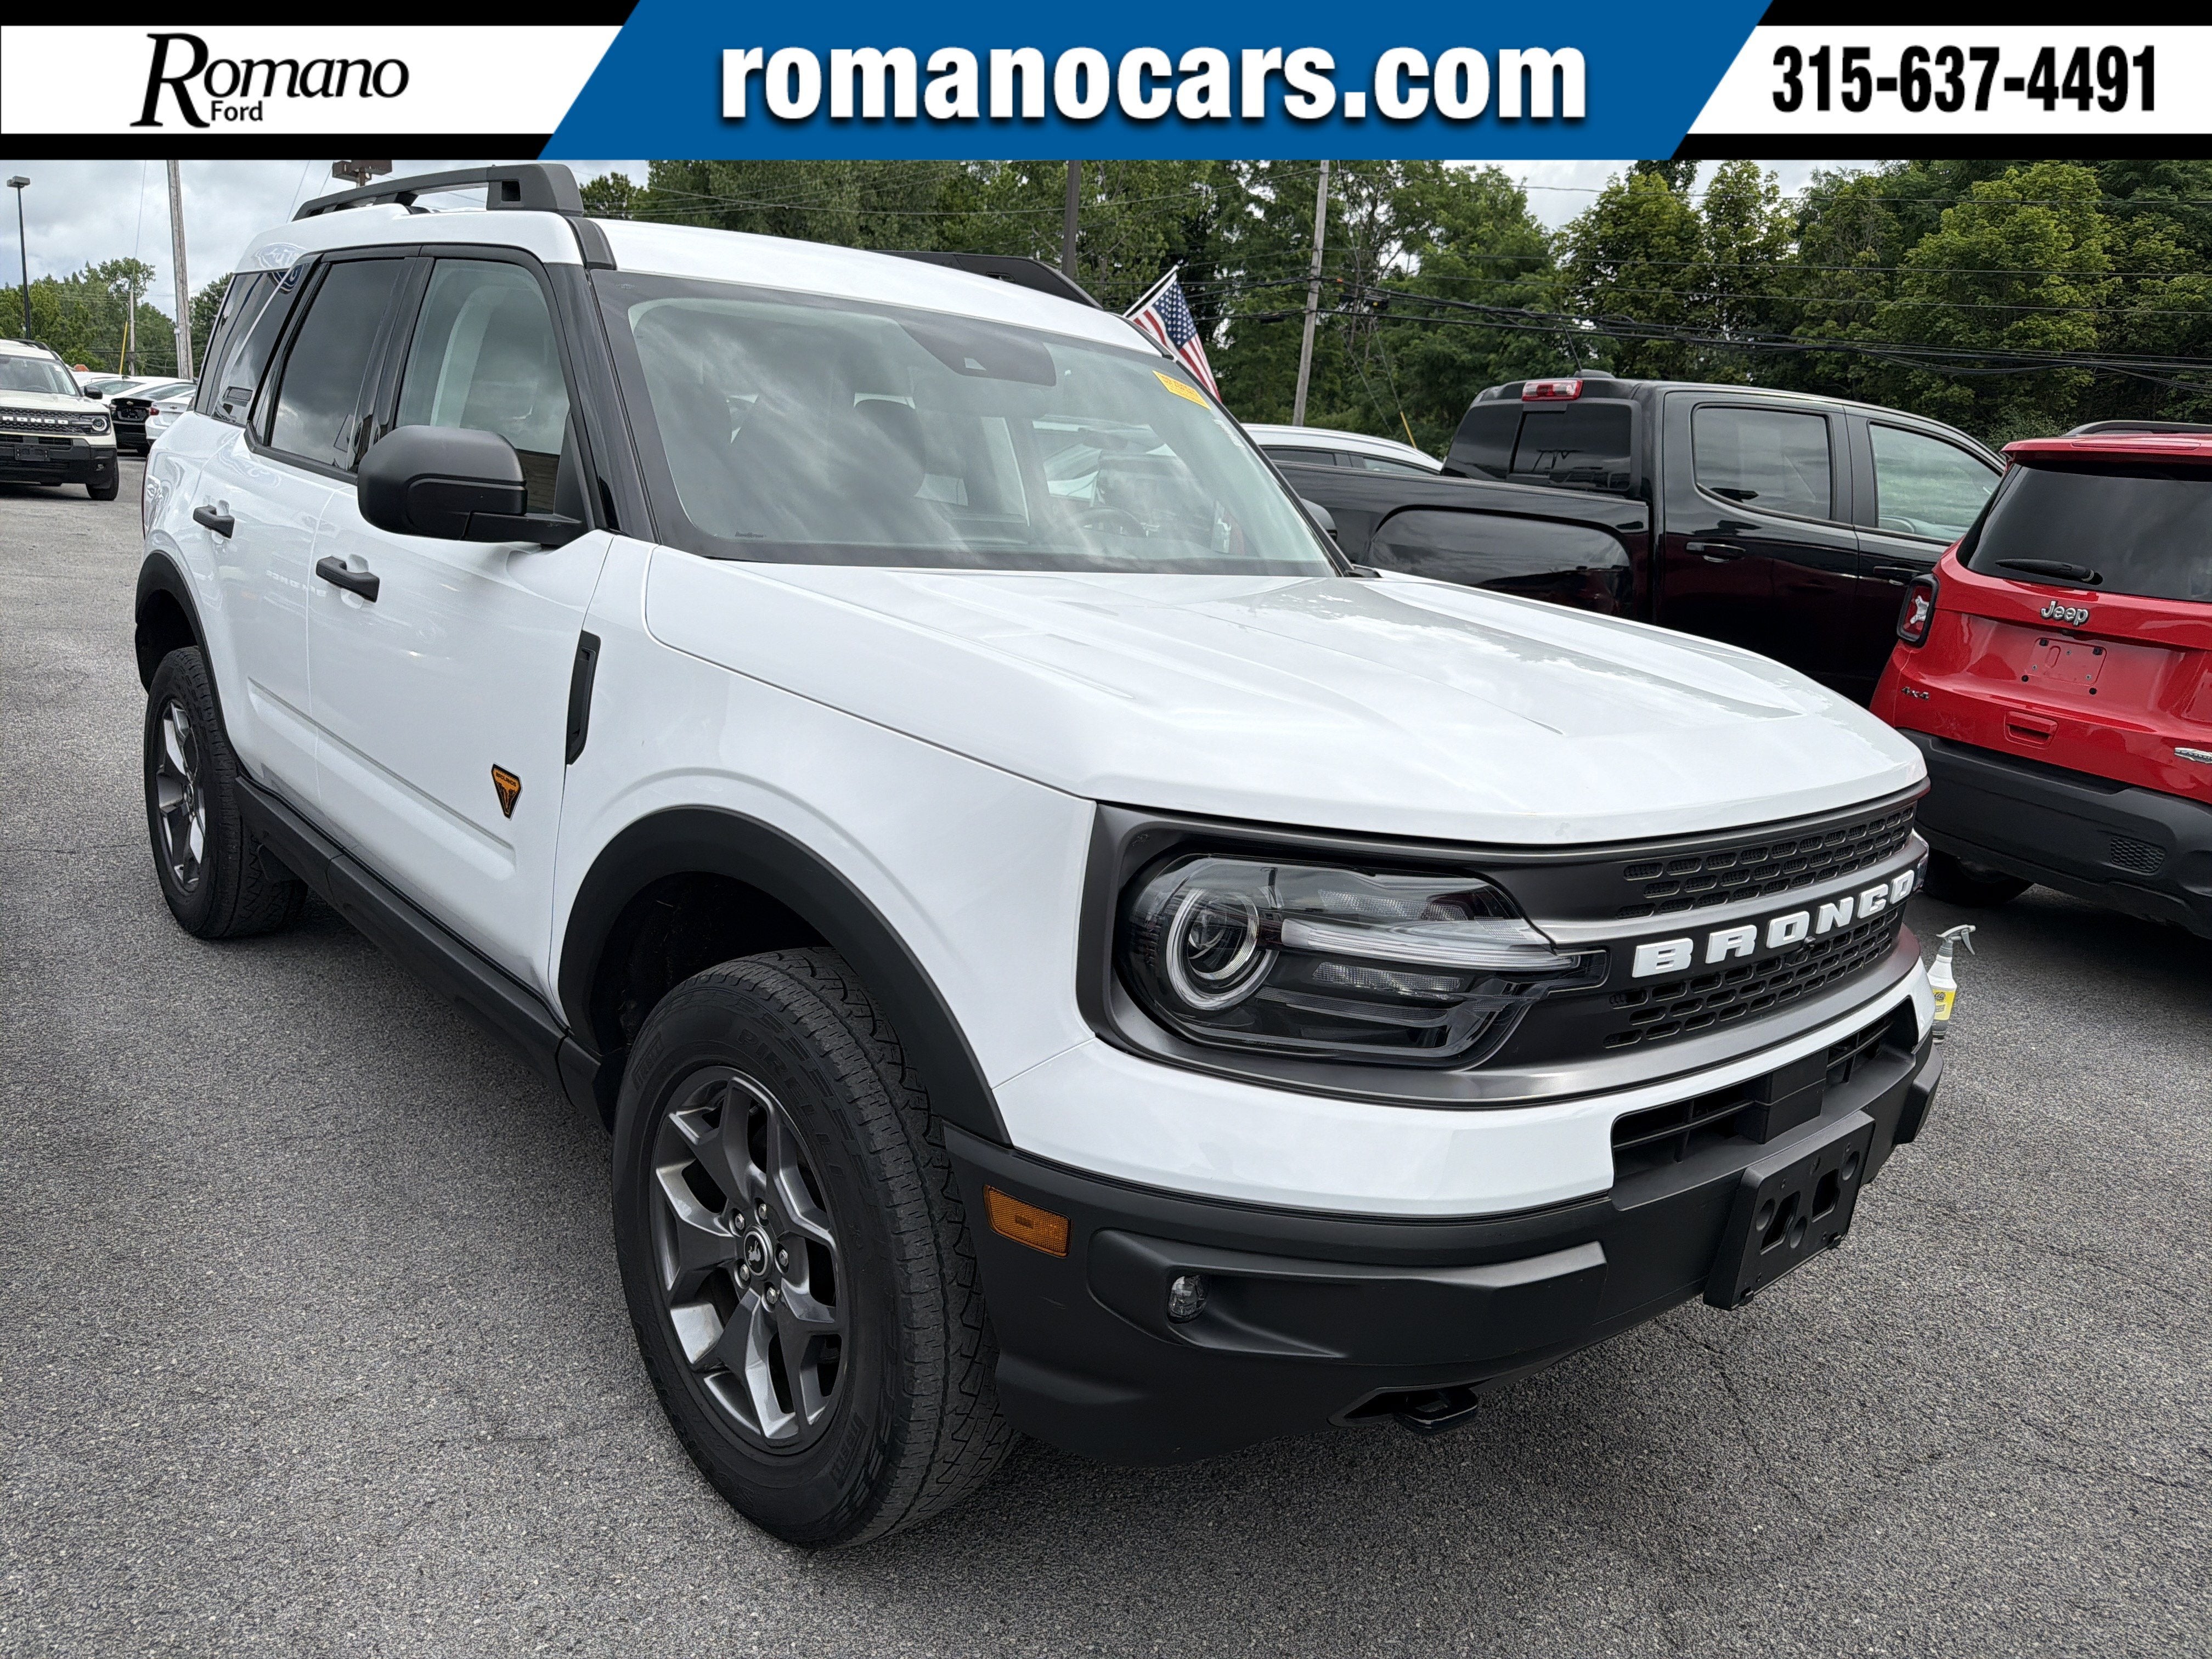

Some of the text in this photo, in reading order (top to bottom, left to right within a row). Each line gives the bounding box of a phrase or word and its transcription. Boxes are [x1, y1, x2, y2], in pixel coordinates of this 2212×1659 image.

[2040, 600, 2089, 626] Jeep
[1632, 870, 1915, 978] BRONCO
[736, 1028, 844, 1177] PIRELLI
